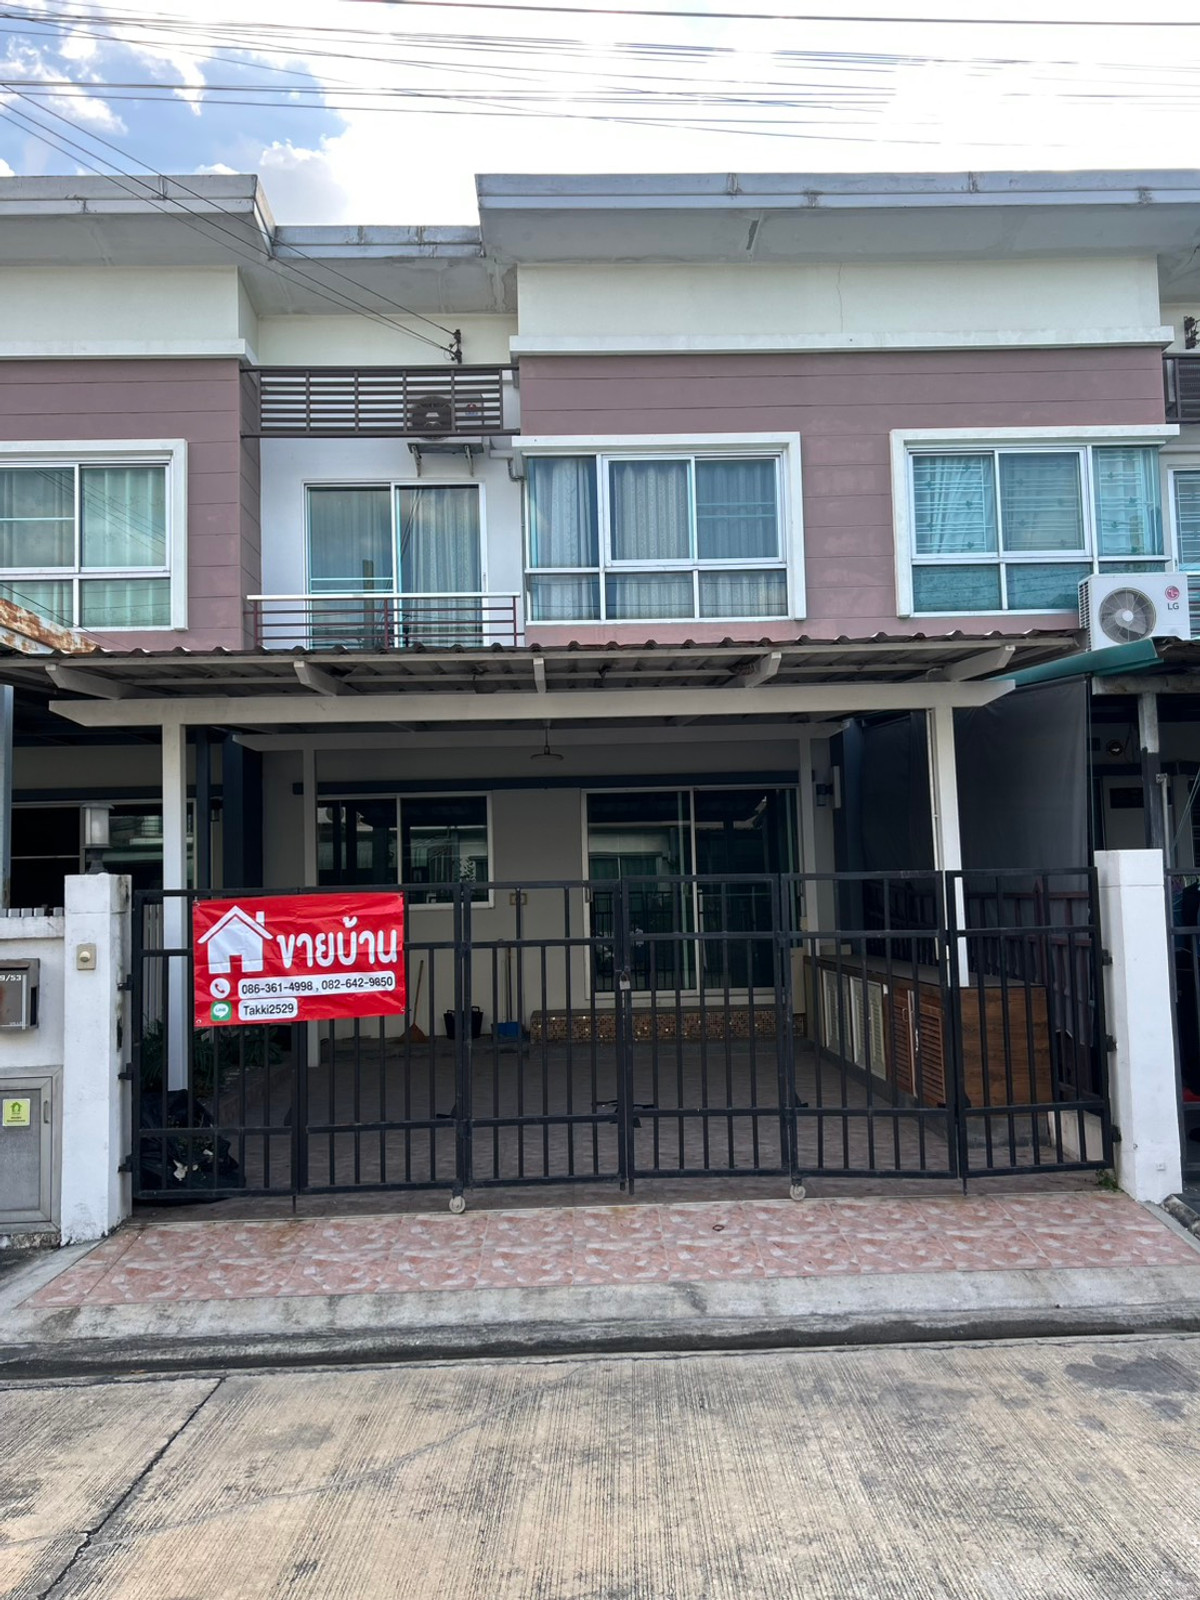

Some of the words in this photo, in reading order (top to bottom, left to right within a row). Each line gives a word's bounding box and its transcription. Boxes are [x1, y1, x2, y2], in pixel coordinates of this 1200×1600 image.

[1167, 602, 1179, 610] LG
[277, 916, 397, 968] ขายบ้าน
[241, 980, 313, 995] 086-361-4998
[243, 1003, 294, 1016] Takki2529
